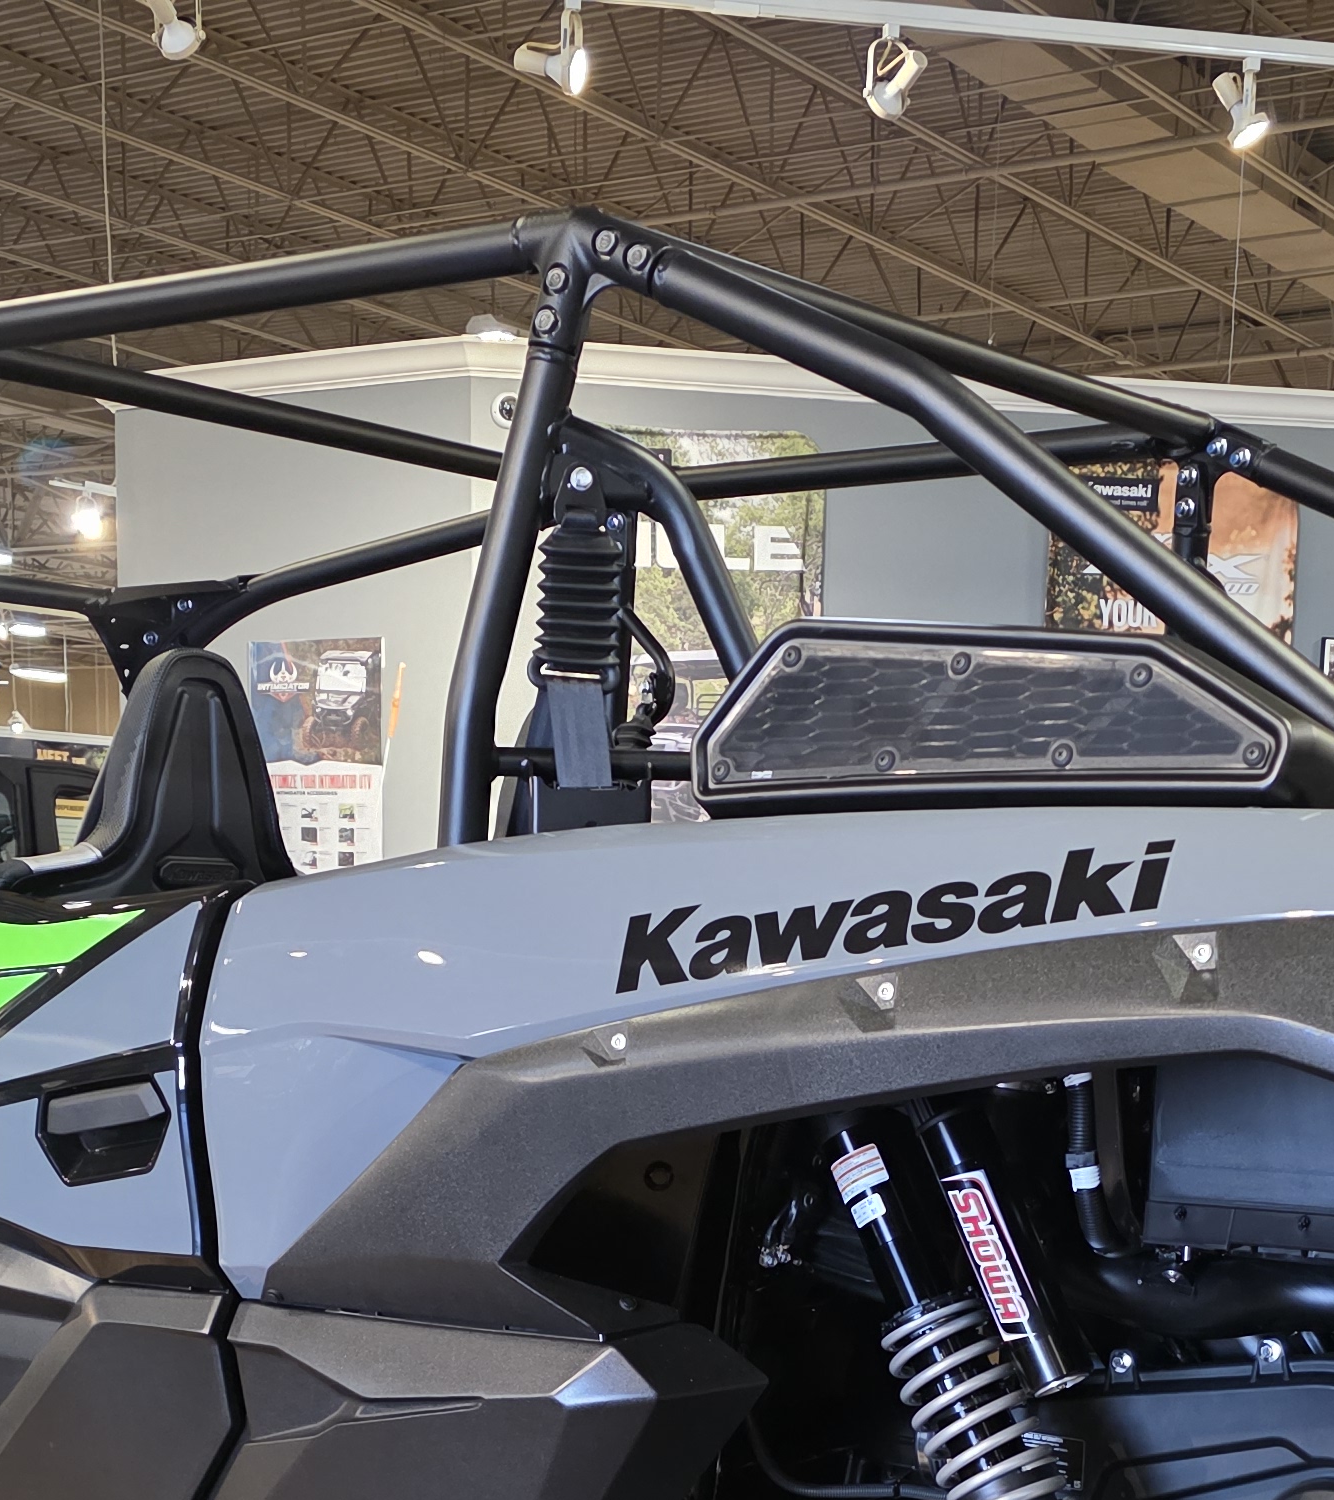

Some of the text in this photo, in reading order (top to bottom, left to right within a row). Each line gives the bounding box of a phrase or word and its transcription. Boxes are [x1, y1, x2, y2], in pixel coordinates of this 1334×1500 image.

[1088, 481, 1152, 498] awasaki
[257, 682, 310, 691] INTIMIDATOR
[614, 839, 1176, 995] Kawasaki
[948, 1188, 1030, 1324] SHOWA
